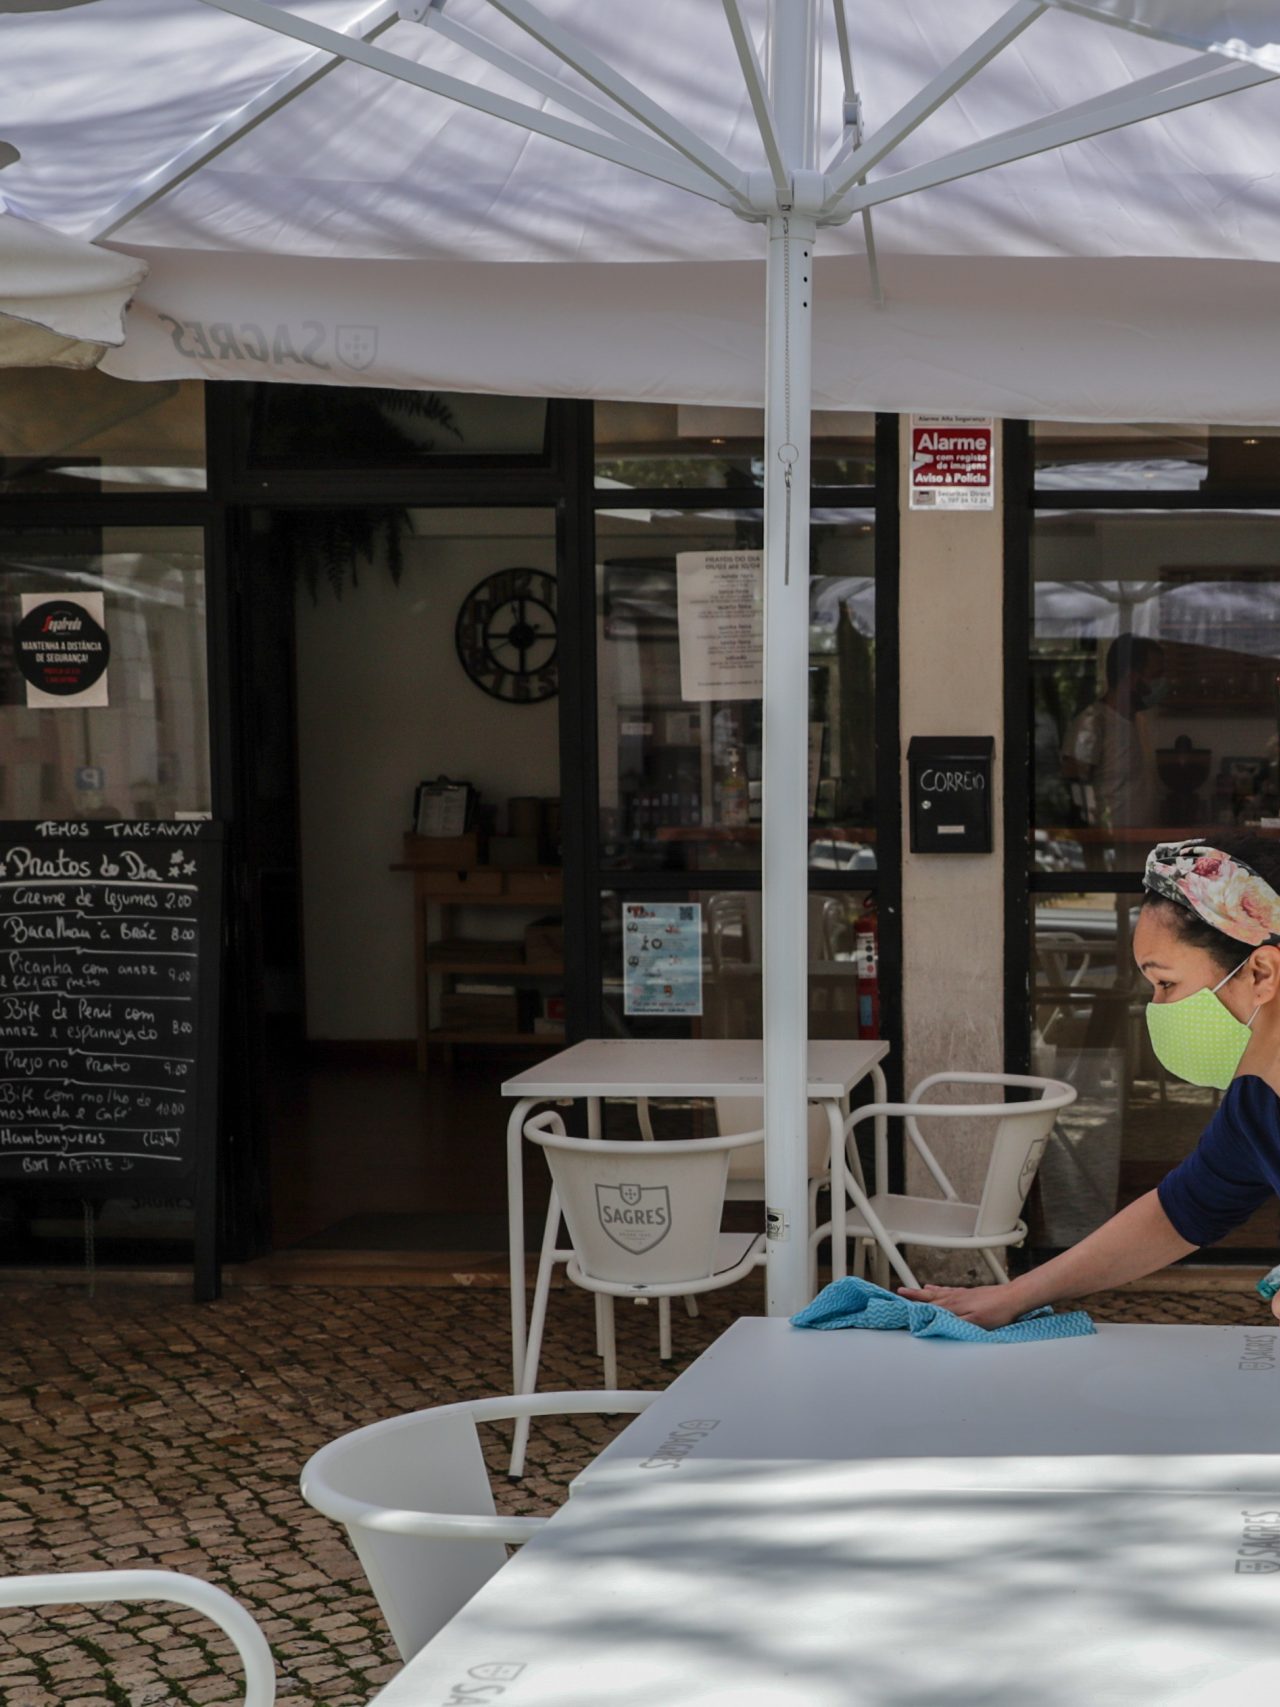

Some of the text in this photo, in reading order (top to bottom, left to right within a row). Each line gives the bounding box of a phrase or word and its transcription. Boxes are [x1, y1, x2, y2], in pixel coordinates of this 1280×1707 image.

[917, 432, 987, 451] Alarme
[936, 454, 954, 462] com
[936, 462, 987, 472] de imagens
[915, 473, 944, 483] Aviso
[22, 640, 103, 651] MANTENHA A DISTÂNCIA
[35, 653, 45, 662] DE
[35, 822, 202, 837] TEMOS TAKE-AWAY
[6, 847, 163, 881] Pratos do Dia
[13, 887, 192, 912] Creme de legumes 2.00
[4, 916, 91, 943] Bacalhau
[171, 926, 195, 941] 8.00
[9, 951, 73, 974] Picanha
[82, 963, 109, 975] com
[3, 997, 41, 1022] Bife
[52, 999, 68, 1020] de
[125, 1008, 155, 1023] com
[48, 1057, 68, 1069] no
[85, 1055, 131, 1073] Prato
[44, 1088, 74, 1102] com
[603, 1205, 666, 1226] SAGRES
[1241, 1335, 1278, 1361] SAGRES
[639, 1431, 709, 1469] SAGRES
